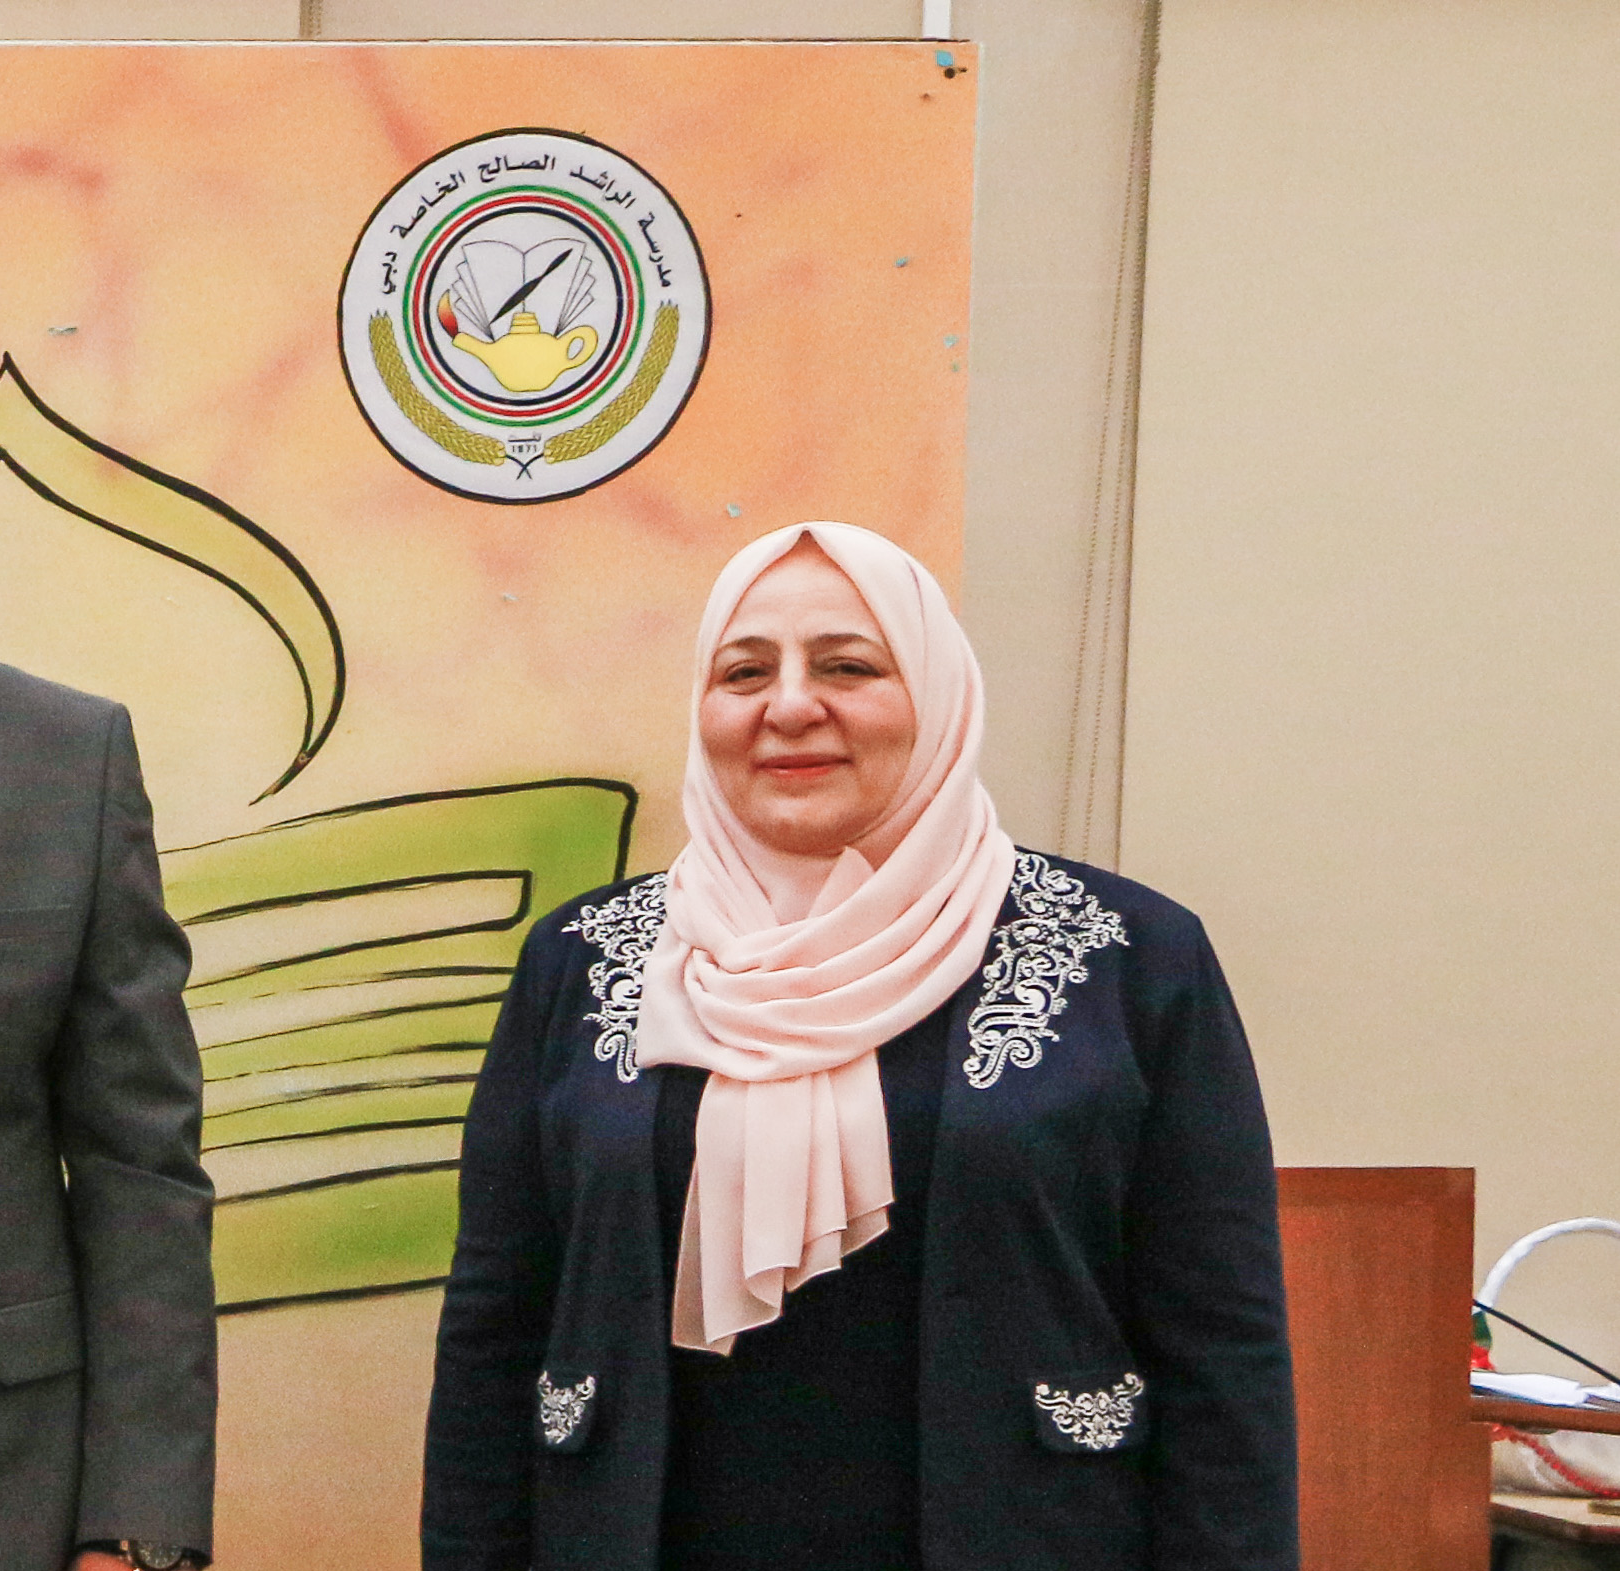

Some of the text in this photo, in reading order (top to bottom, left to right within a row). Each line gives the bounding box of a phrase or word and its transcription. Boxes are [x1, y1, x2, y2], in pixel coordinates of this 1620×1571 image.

[381, 153, 671, 295] مدرسة الراشد الصالح الخاصة دبي
